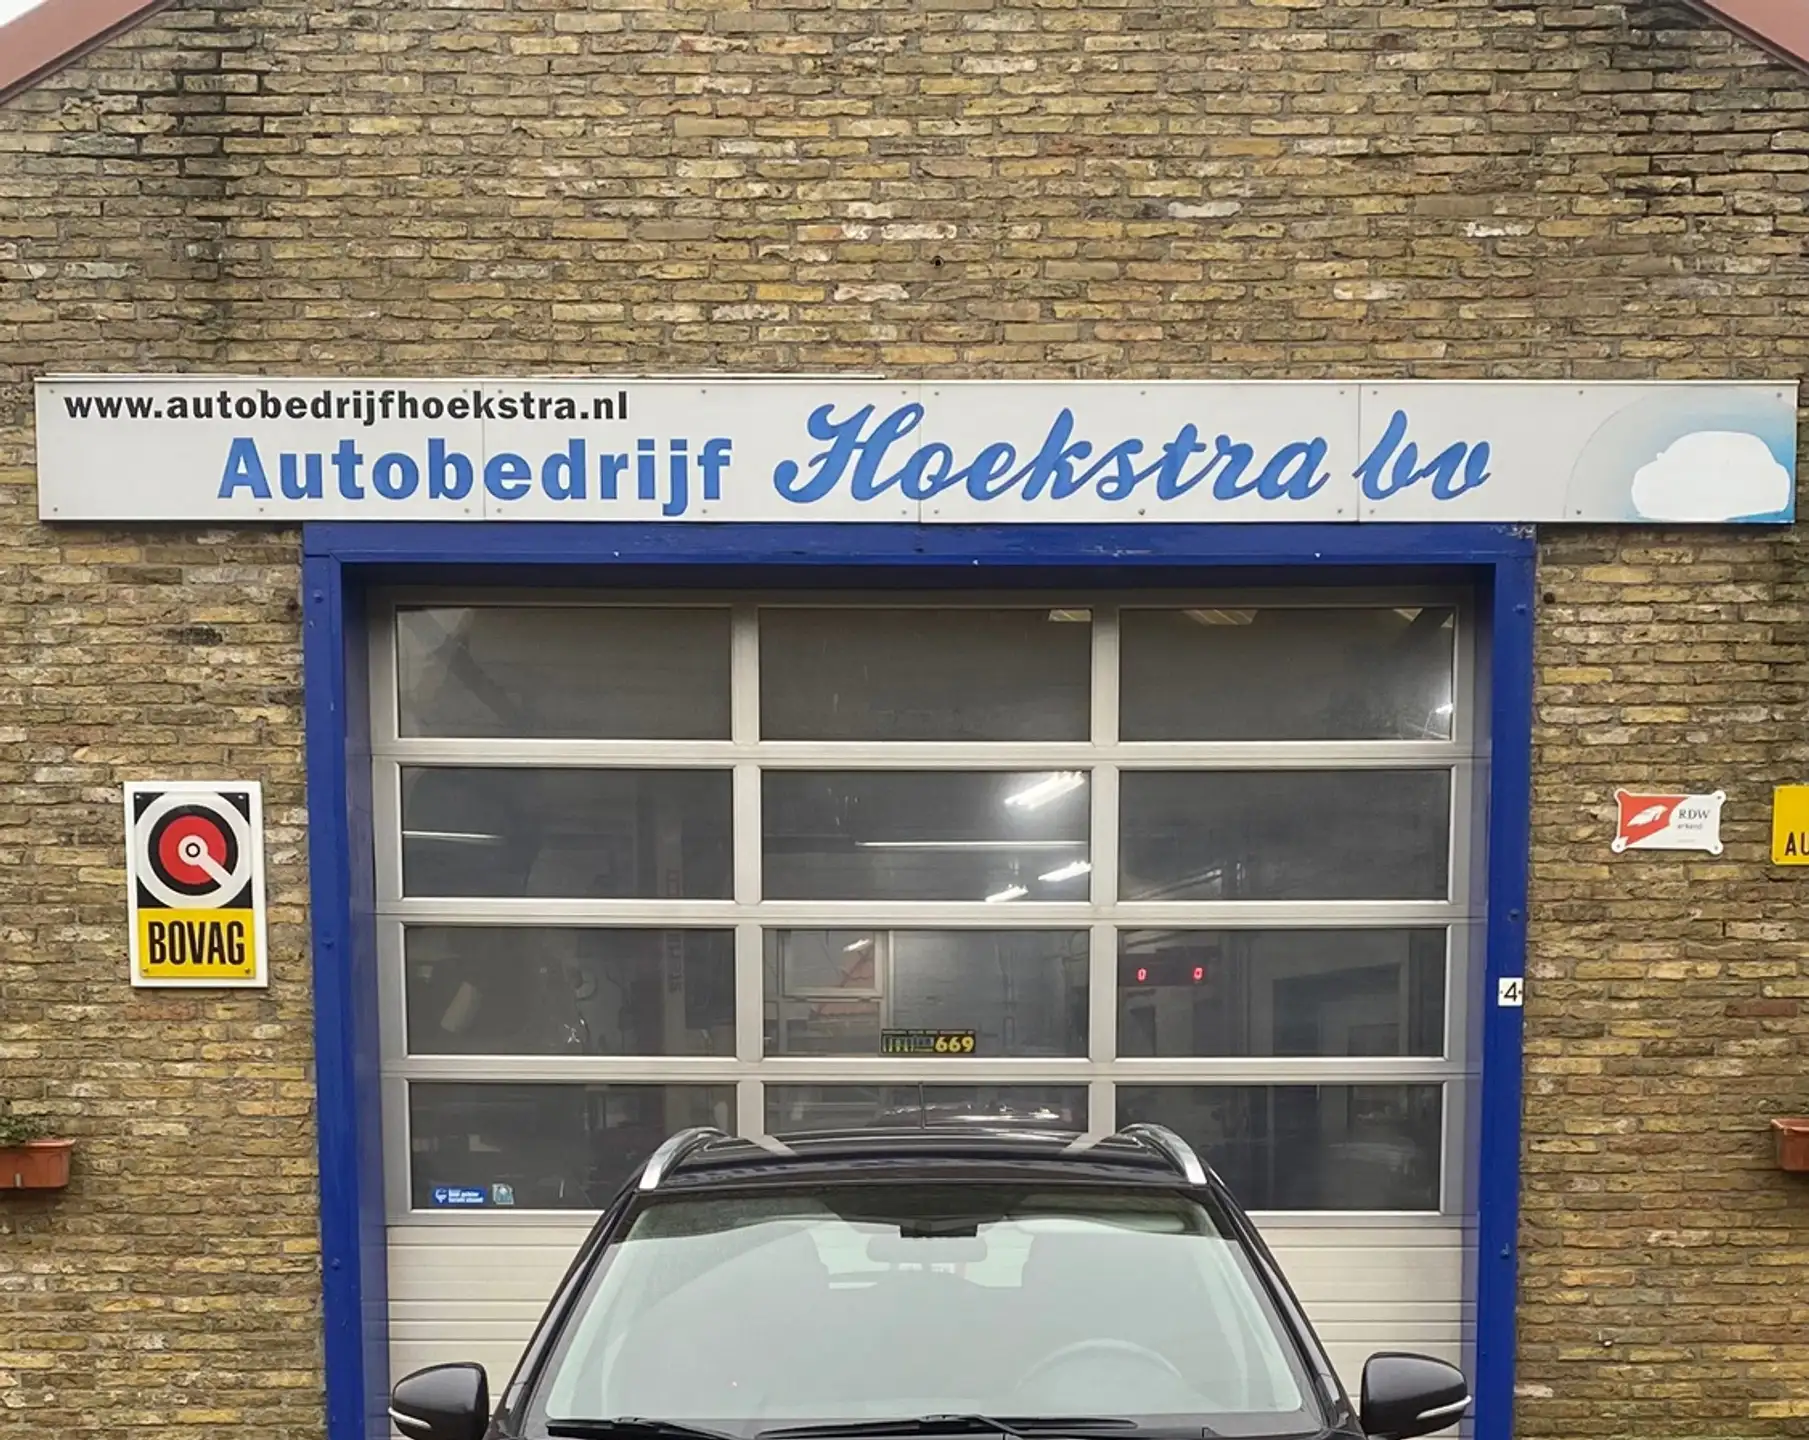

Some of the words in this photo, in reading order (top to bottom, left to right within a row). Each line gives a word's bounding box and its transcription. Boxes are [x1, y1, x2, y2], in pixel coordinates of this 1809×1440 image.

[64, 390, 627, 427] www.autobedrijfhoekstra.nl
[217, 437, 733, 517] Autobedrijf
[773, 402, 1330, 504] Hoekstra
[1352, 409, 1491, 501] bv
[1678, 808, 1711, 820] RDW
[147, 919, 246, 966] BOVAG
[1503, 981, 1518, 1002] 4
[935, 1036, 975, 1053] 669
